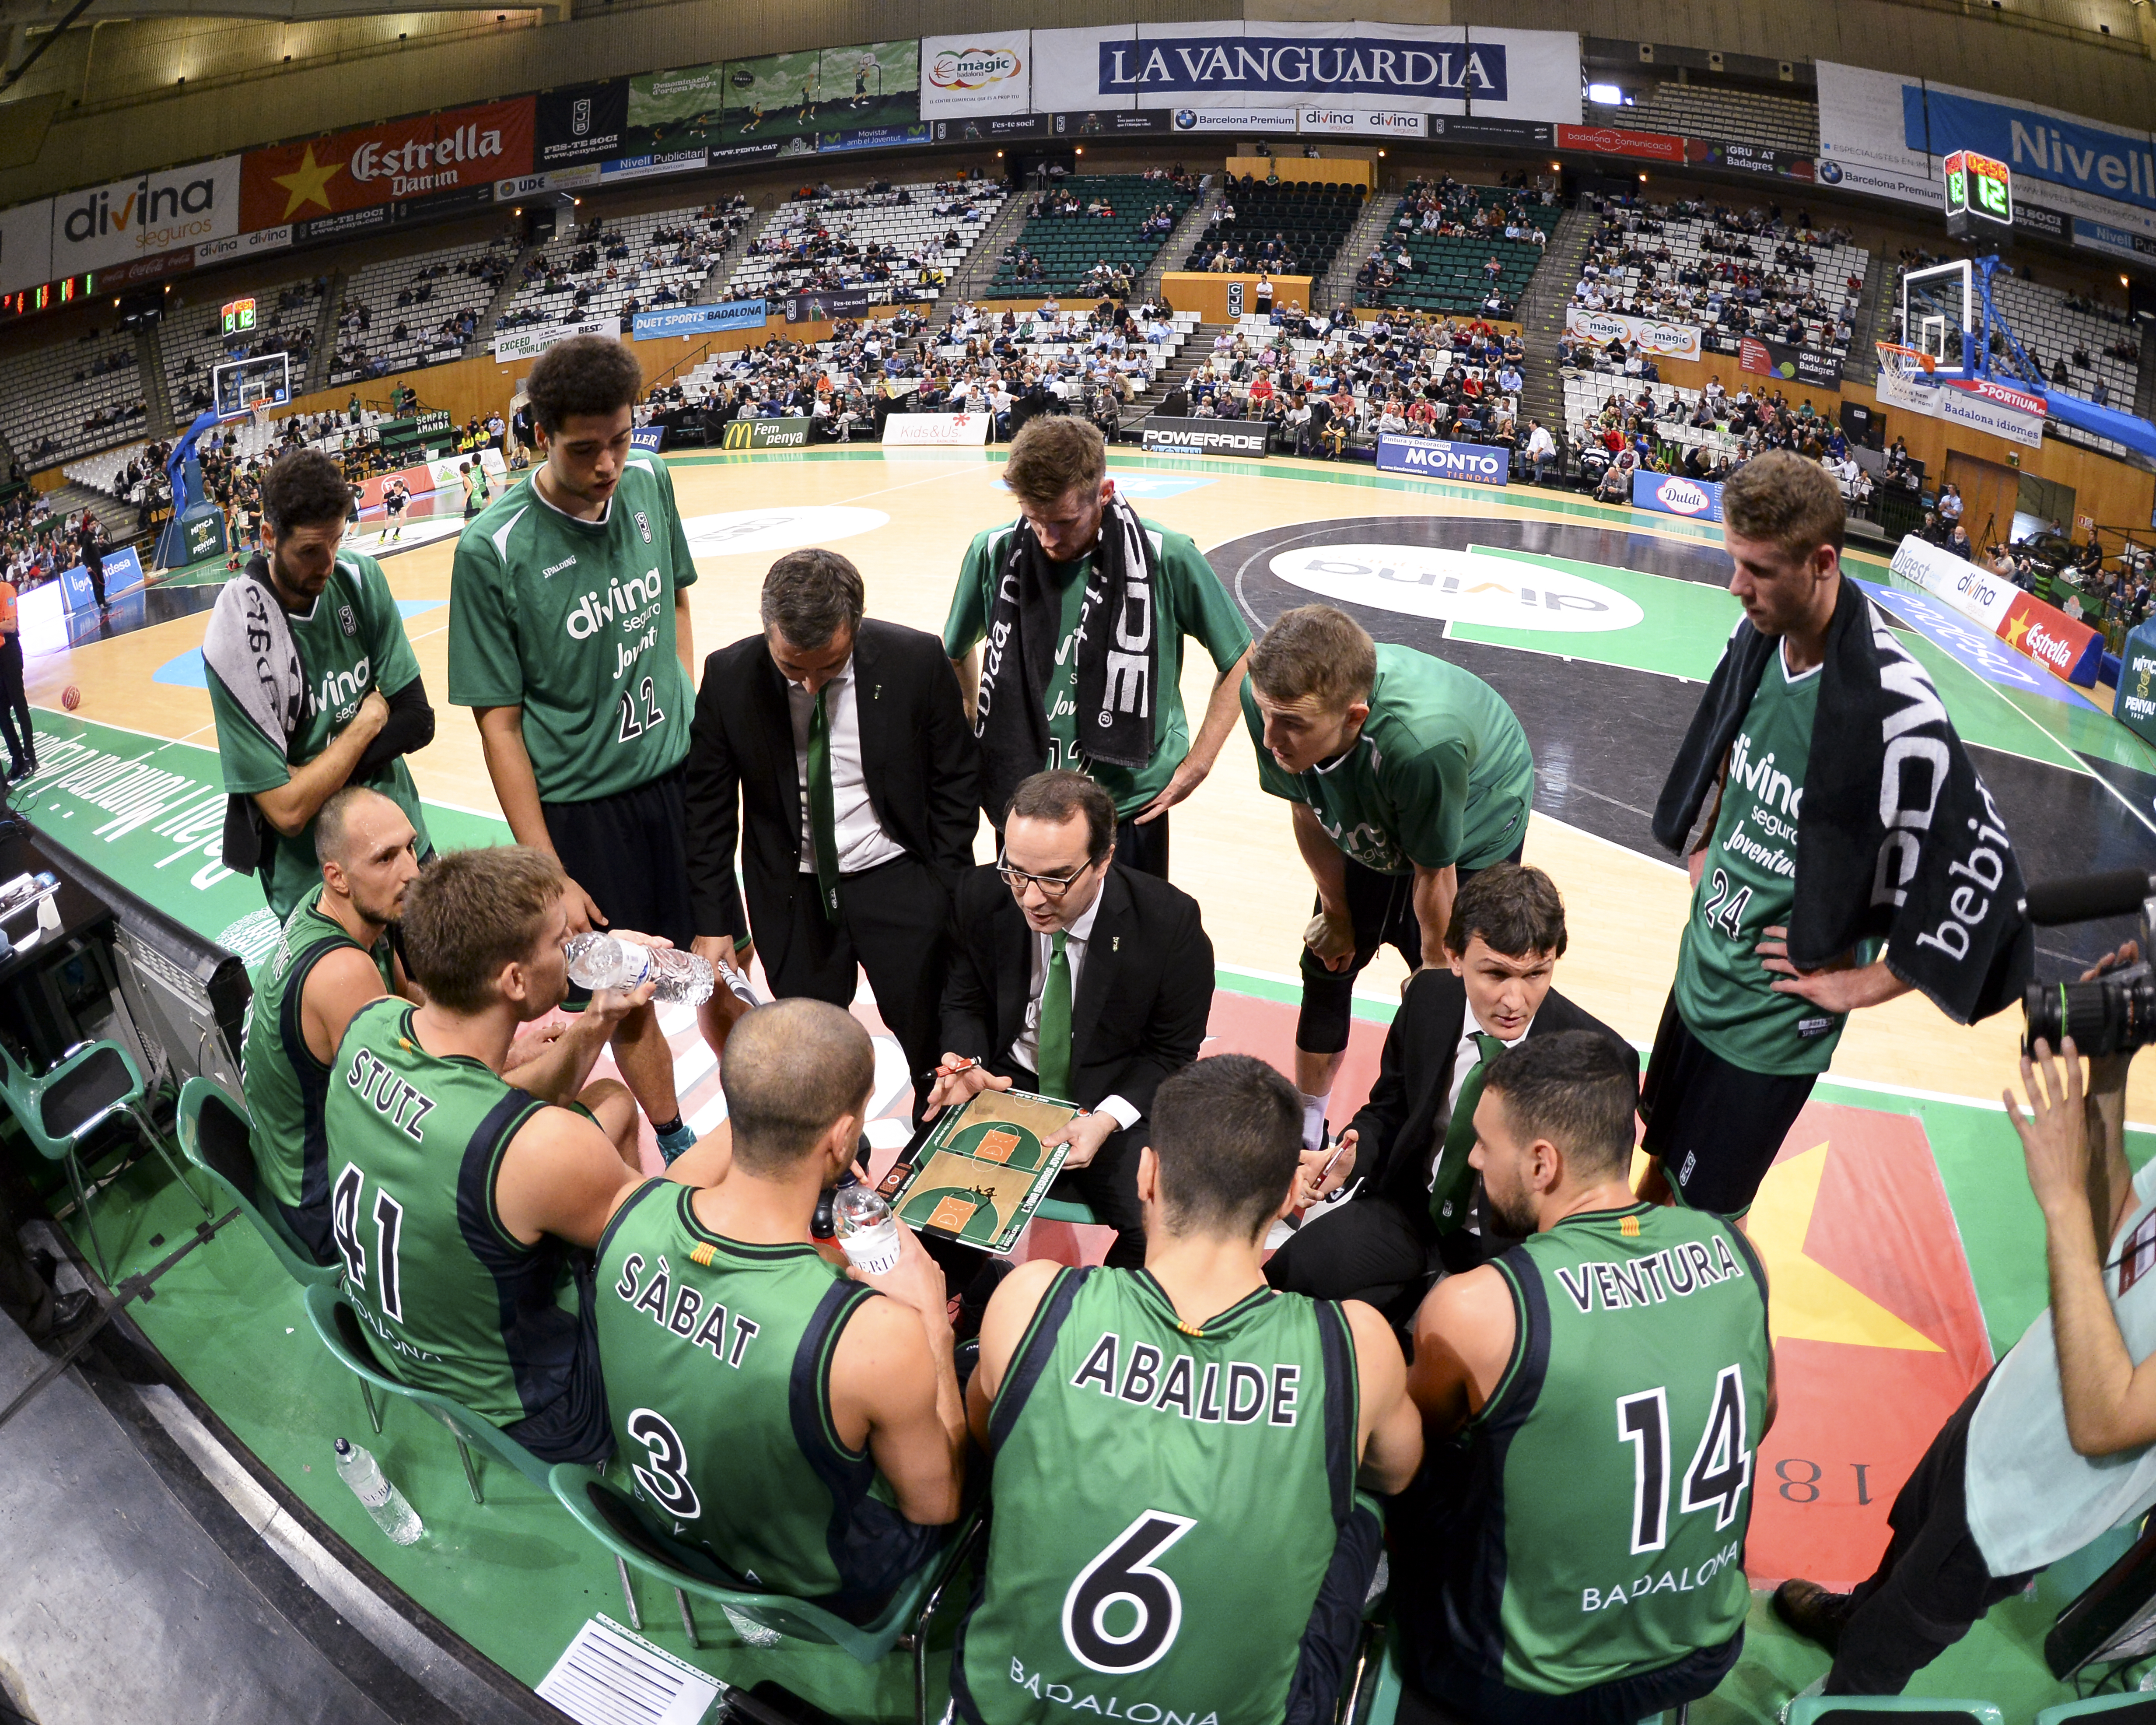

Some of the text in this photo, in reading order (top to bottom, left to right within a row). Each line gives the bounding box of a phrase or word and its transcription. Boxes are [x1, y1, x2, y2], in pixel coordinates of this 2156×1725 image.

[957, 56, 1010, 74] màgic
[1111, 45, 1495, 89] LA VANGUARDIA
[653, 75, 710, 89] Denominació
[689, 81, 717, 91] Penya
[992, 119, 1034, 129] Fes-te soci!
[1199, 116, 1295, 125] Barcelona Premium
[1306, 111, 1354, 125] divina
[1370, 112, 1418, 128] divina
[544, 134, 618, 154] FES-TE SOCI
[871, 135, 901, 145] Joventut
[1568, 133, 1672, 152] badalona comunicació
[351, 123, 503, 182] Estrella
[544, 142, 617, 161] www.penya.com
[620, 148, 704, 169] Nivell Publicitari
[2011, 120, 2156, 200] Nivell
[1726, 156, 1773, 172] Badagres
[1915, 158, 1944, 175] IMPRE
[1968, 154, 2008, 183] 02:56
[392, 169, 458, 196] Damm
[519, 176, 545, 192] UDE
[1845, 172, 1943, 201] Barcelona Premium
[1978, 174, 2007, 214] 12
[64, 177, 214, 243] divina
[310, 207, 384, 230] FES-TE SOCI
[2026, 209, 2062, 226] SOCI
[136, 218, 212, 250] seguros
[311, 216, 384, 236] www.penya.com
[249, 228, 287, 245] divina
[2096, 226, 2132, 248] Nivell
[200, 240, 237, 257] divina
[240, 309, 254, 328] 12
[636, 305, 762, 329] DUET SPORTS BADALONA
[578, 324, 602, 334] BEST
[1590, 323, 1623, 334] màgic
[1654, 332, 1687, 344] màgic
[500, 336, 530, 353] EXCEED
[518, 344, 535, 355] YOUR
[1799, 361, 1835, 376] Badagres
[1915, 390, 1928, 399] hem
[417, 421, 450, 435] AMANDA
[754, 422, 780, 436] Fem
[900, 425, 959, 438] Kids&Us
[1944, 403, 2039, 440] Badalona idiomes
[630, 434, 658, 447] ALER
[765, 431, 803, 446] penya
[1143, 429, 1263, 450] POWERADE
[1383, 436, 1407, 444] Pintura
[1414, 439, 1450, 449] Decoración
[436, 467, 445, 482] LEROY
[1447, 471, 1498, 484] TIENDAS
[1665, 487, 1701, 506] Duldi
[190, 518, 214, 535] MÍTICA
[192, 535, 217, 554] PENYA!
[102, 558, 131, 576] ndesa
[542, 555, 577, 579] SPALDING
[1304, 559, 1610, 612] divina
[1957, 573, 1997, 607] divina
[567, 567, 662, 639] divina
[623, 603, 661, 632] seguro
[1880, 590, 2040, 686] endesa
[2026, 622, 2072, 668] Estrella
[307, 656, 369, 718] ivina
[617, 676, 665, 744] 22
[2125, 696, 2156, 716] PENYA!
[1723, 819, 1797, 879] Joventu
[1704, 867, 1753, 941] 24
[347, 1048, 437, 1143] STUTZ
[1033, 1165, 1055, 1195] SEGUROS
[1048, 1139, 1071, 1169] JOVENTU
[332, 1161, 404, 1325] 41
[1003, 1223, 1022, 1248] BADALONA
[1554, 1234, 1745, 1314] VENTURA
[615, 1252, 760, 1369] SÀBAT
[1069, 1331, 1301, 1427] ABALDE
[627, 1407, 701, 1519] 3
[1616, 1363, 1751, 1555] 14
[1582, 1539, 1738, 1613] BADALONA
[1061, 1508, 1198, 1675] 6
[1009, 1656, 1218, 1725] BADALONA
